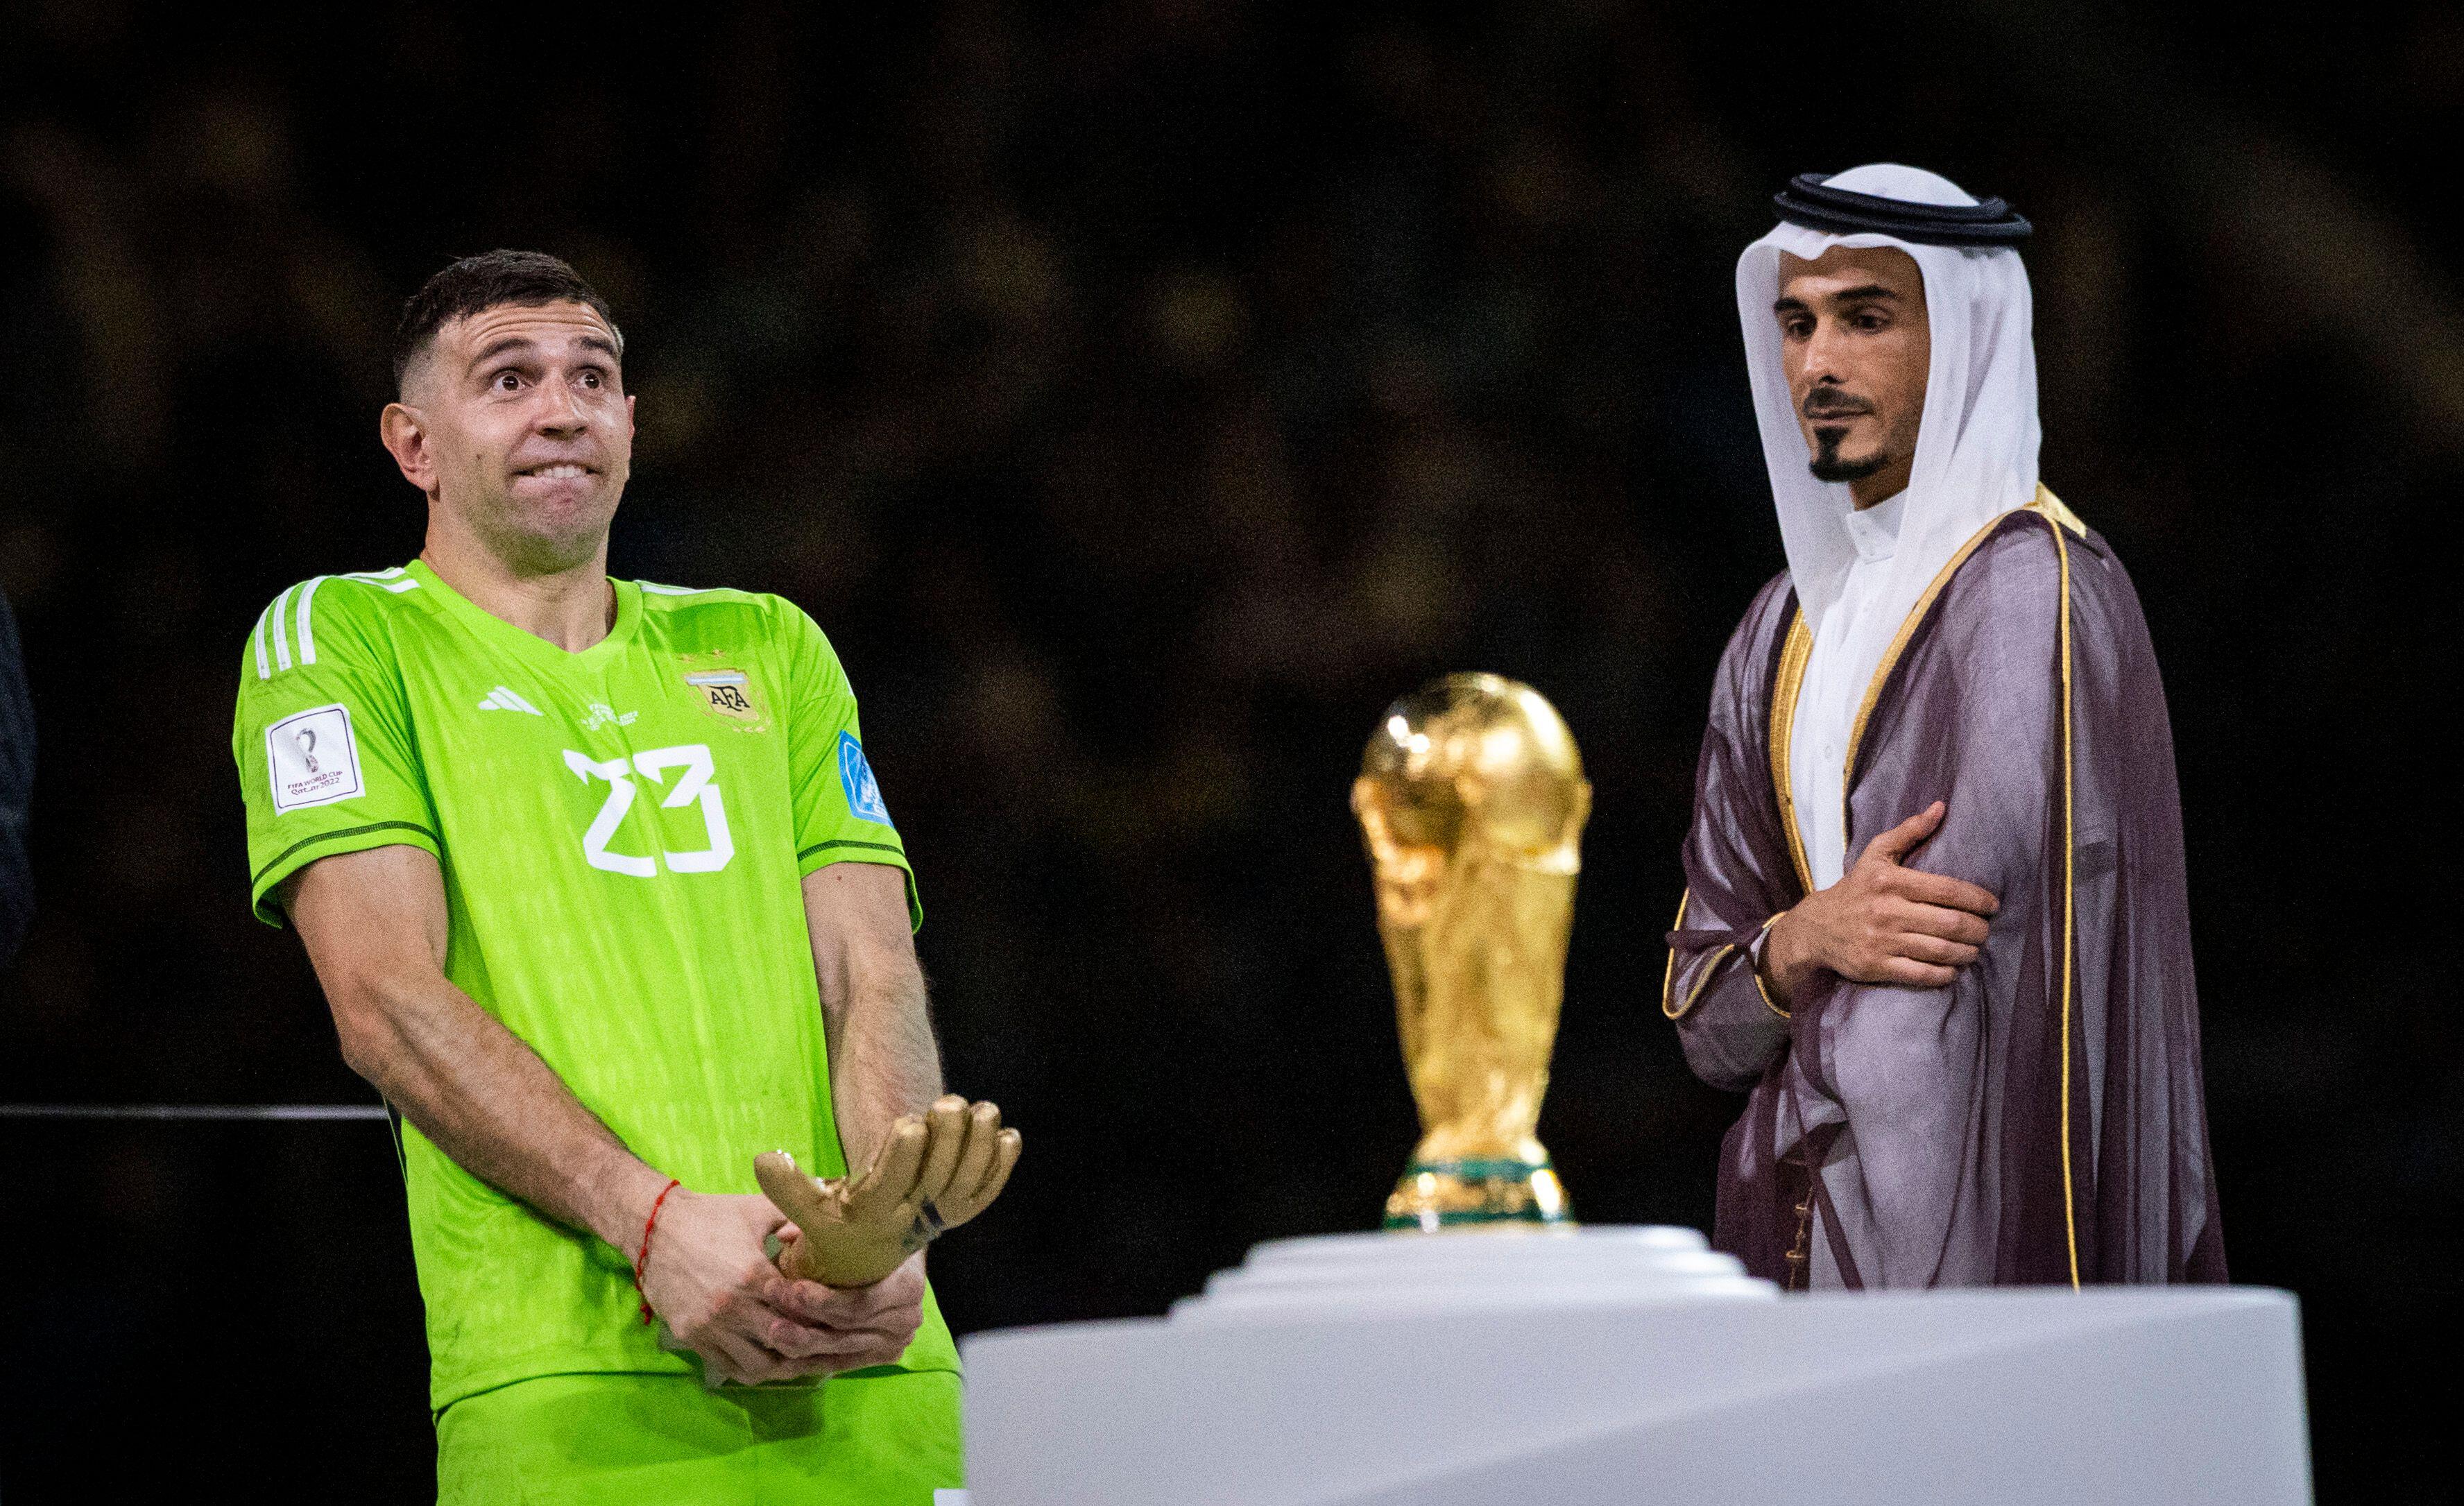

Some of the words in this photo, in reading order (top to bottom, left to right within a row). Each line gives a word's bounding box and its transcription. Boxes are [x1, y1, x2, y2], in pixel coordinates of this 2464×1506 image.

[708, 685, 750, 712] AFA
[305, 773, 327, 786] WORLD
[320, 777, 340, 789] 2022
[563, 744, 735, 878] 23
